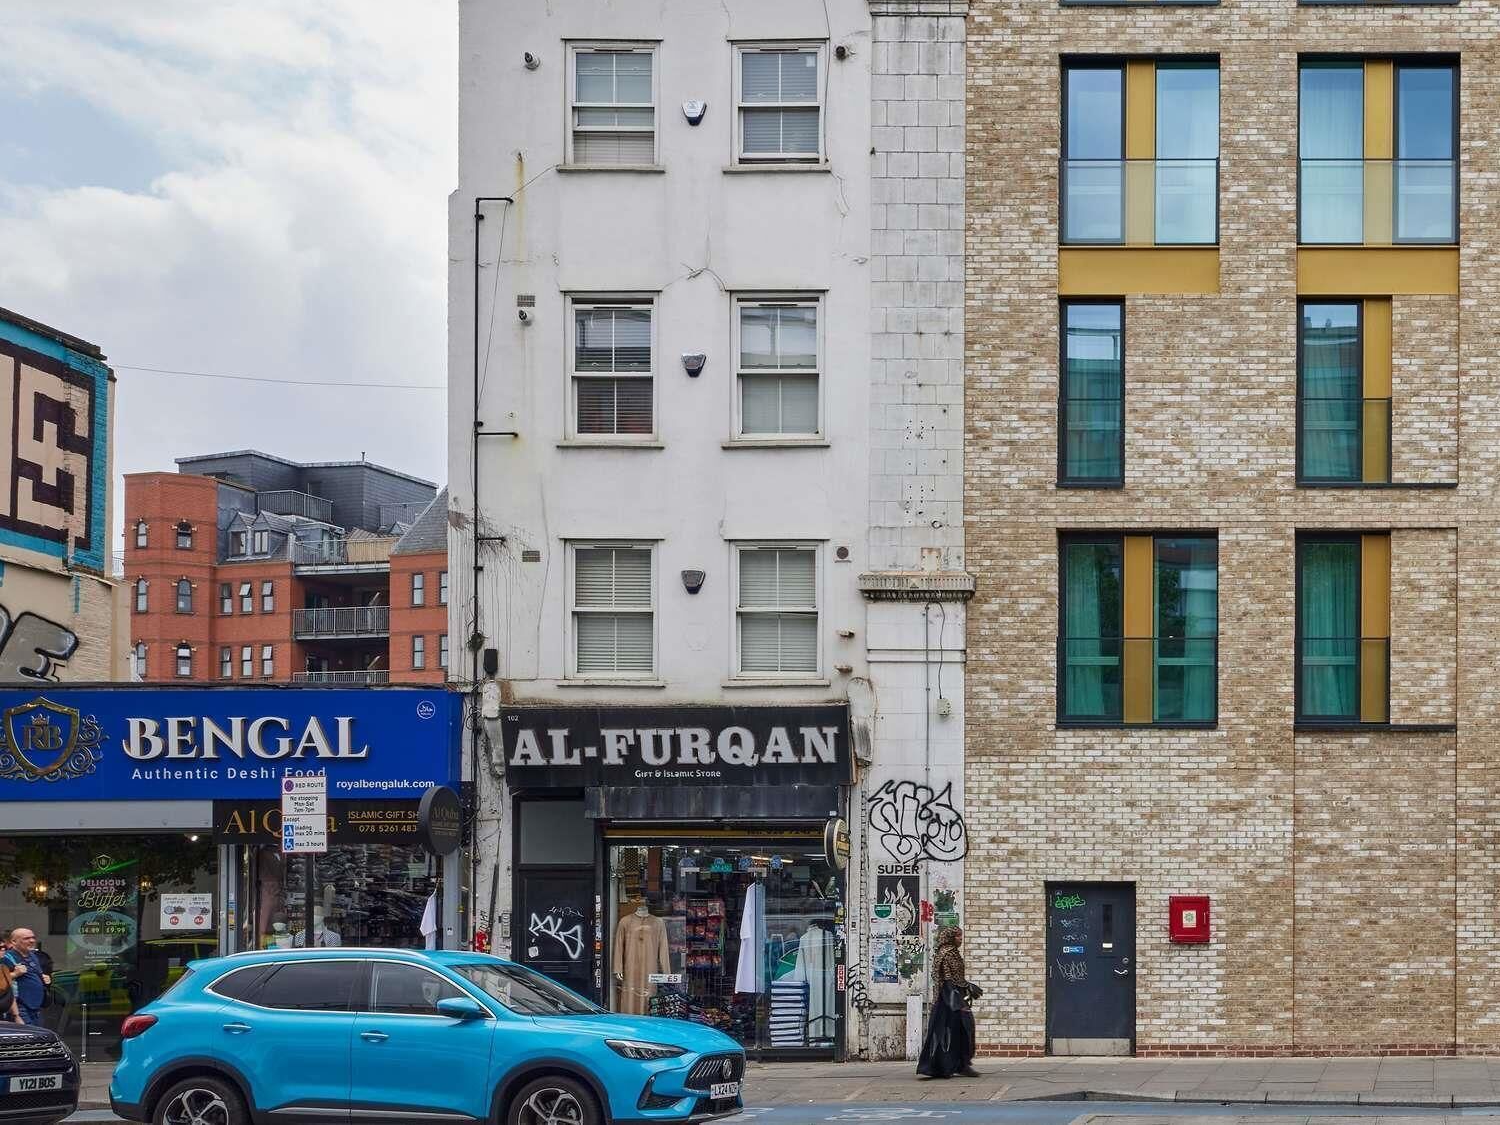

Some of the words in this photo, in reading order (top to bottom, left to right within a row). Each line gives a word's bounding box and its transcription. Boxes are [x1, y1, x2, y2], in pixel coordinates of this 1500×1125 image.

[122, 715, 369, 760] BENGAL
[509, 725, 839, 767] AL-FURQAN
[132, 768, 218, 780] Authentic
[227, 768, 275, 779] Deshi
[284, 767, 326, 778] Food
[336, 778, 435, 790] royalbengaluk.com
[348, 811, 384, 819] ISLAMIC
[386, 811, 405, 819] GIFT
[877, 864, 919, 875] SUPER
